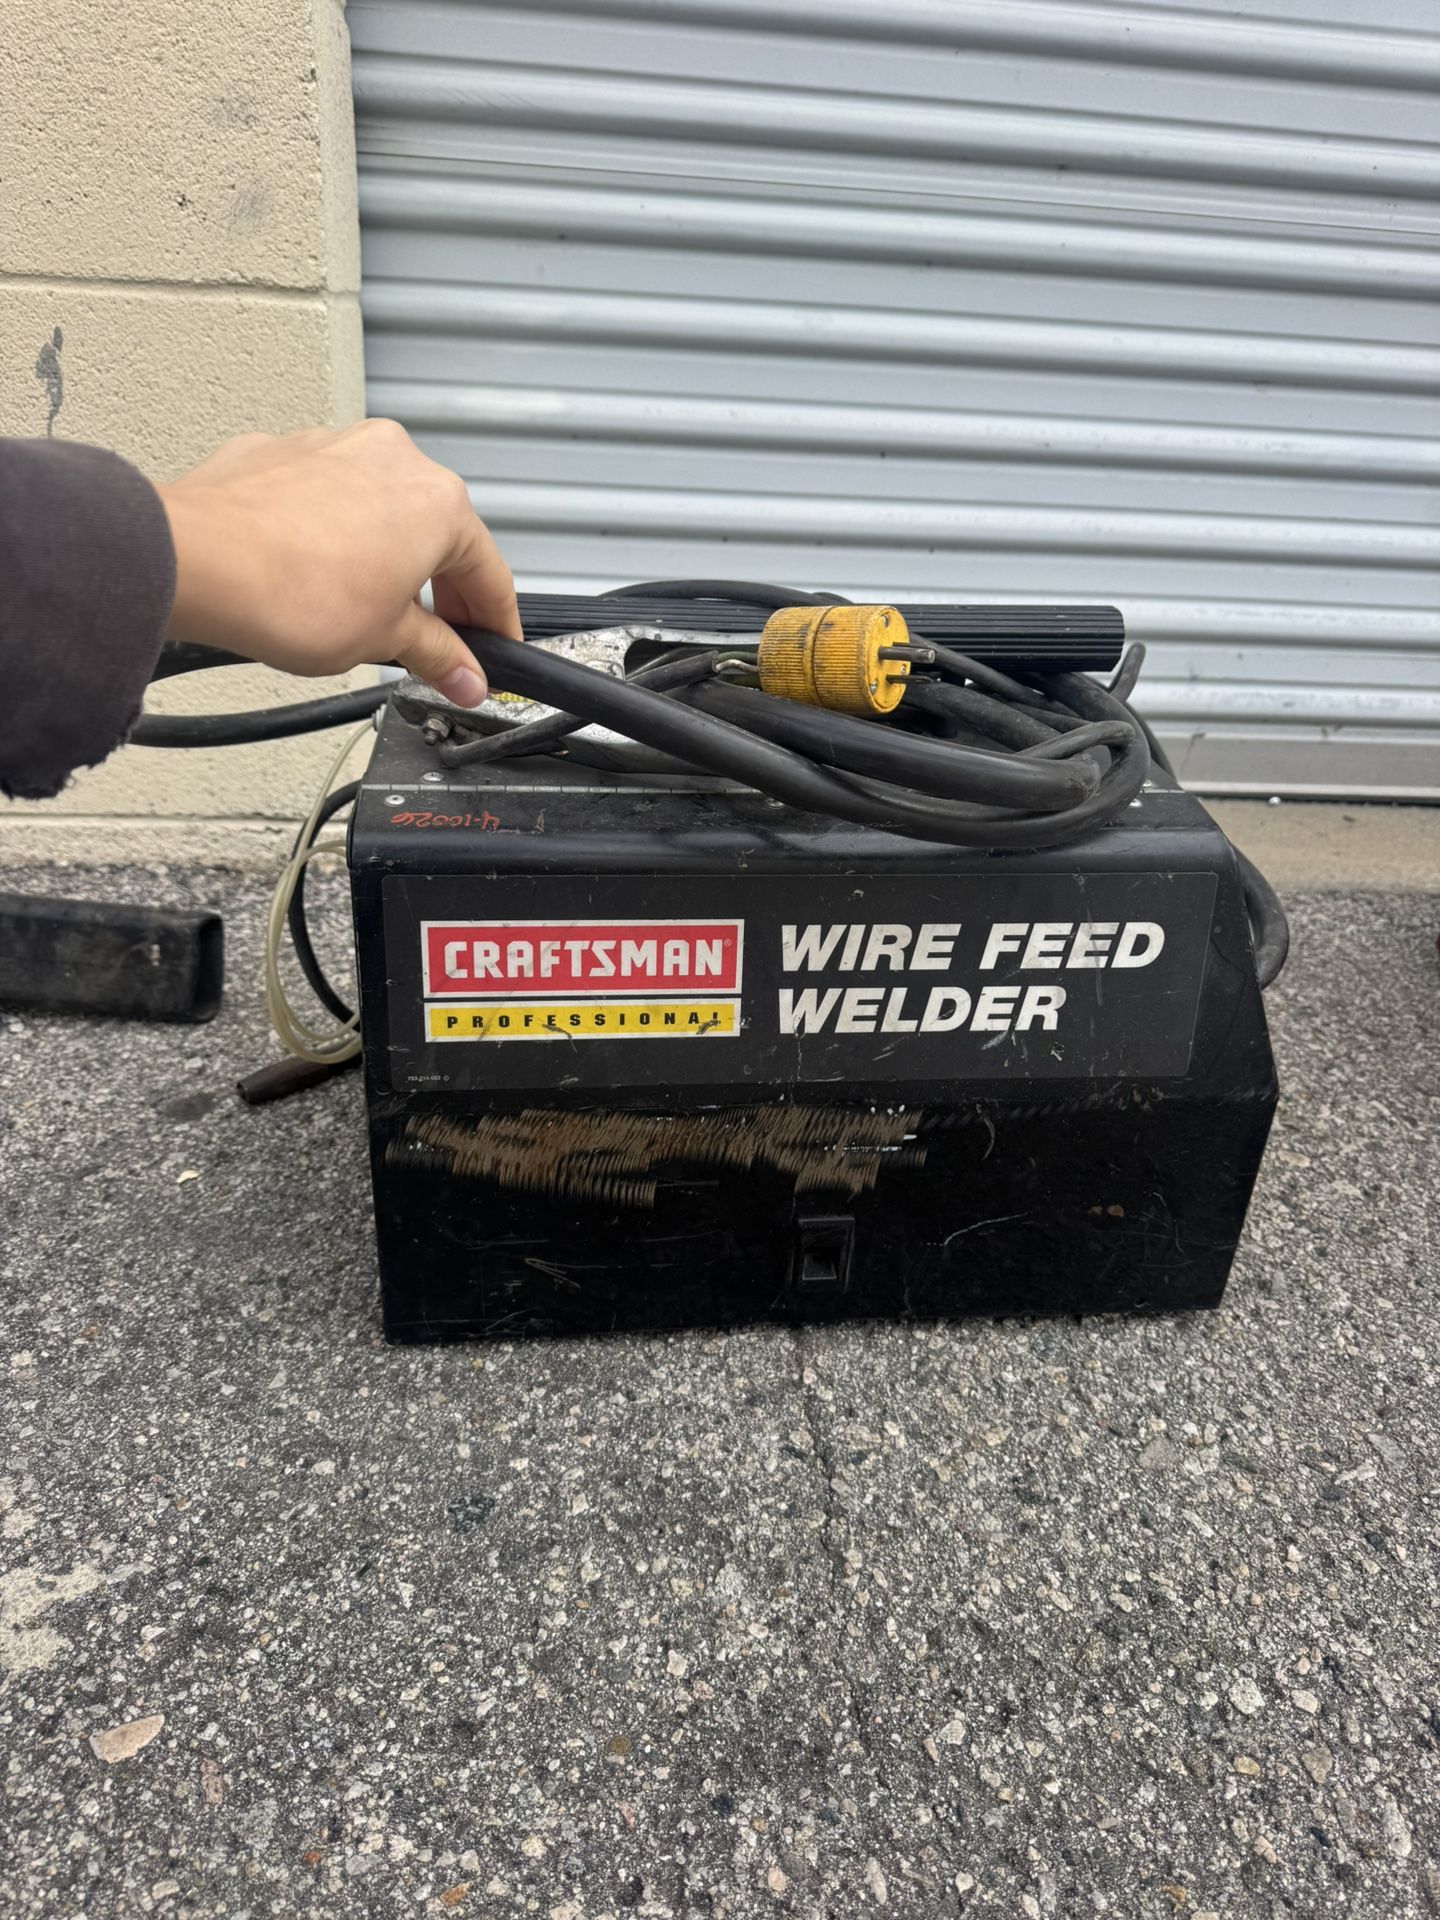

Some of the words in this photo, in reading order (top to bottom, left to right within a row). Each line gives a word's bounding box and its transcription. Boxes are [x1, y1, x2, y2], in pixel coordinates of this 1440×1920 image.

[781, 923, 961, 971] WIRE
[979, 922, 1165, 969] FEED
[778, 985, 1066, 1033] WELDER
